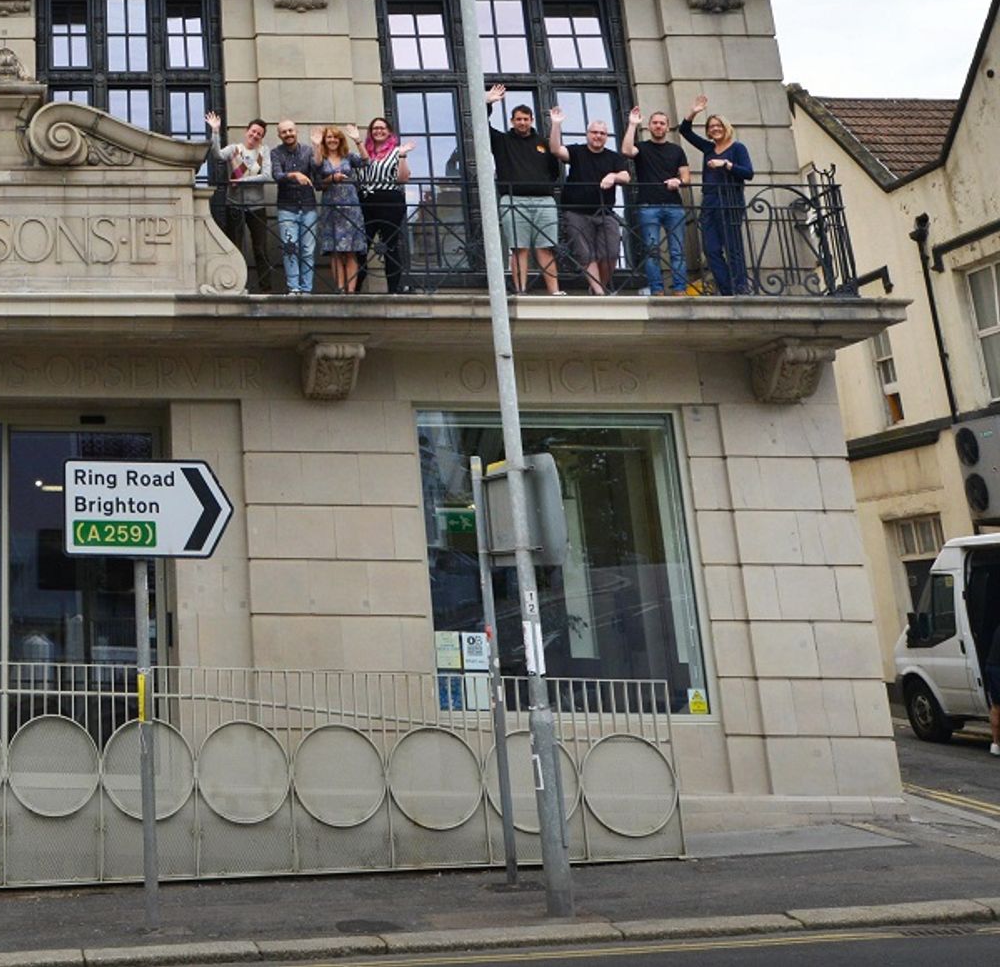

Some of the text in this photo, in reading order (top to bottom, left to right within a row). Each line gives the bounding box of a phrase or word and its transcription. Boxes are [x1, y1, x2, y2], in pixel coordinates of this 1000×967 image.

[459, 357, 641, 395] OFICES
[74, 469, 175, 489] Ring Road
[74, 496, 160, 516] Brighton
